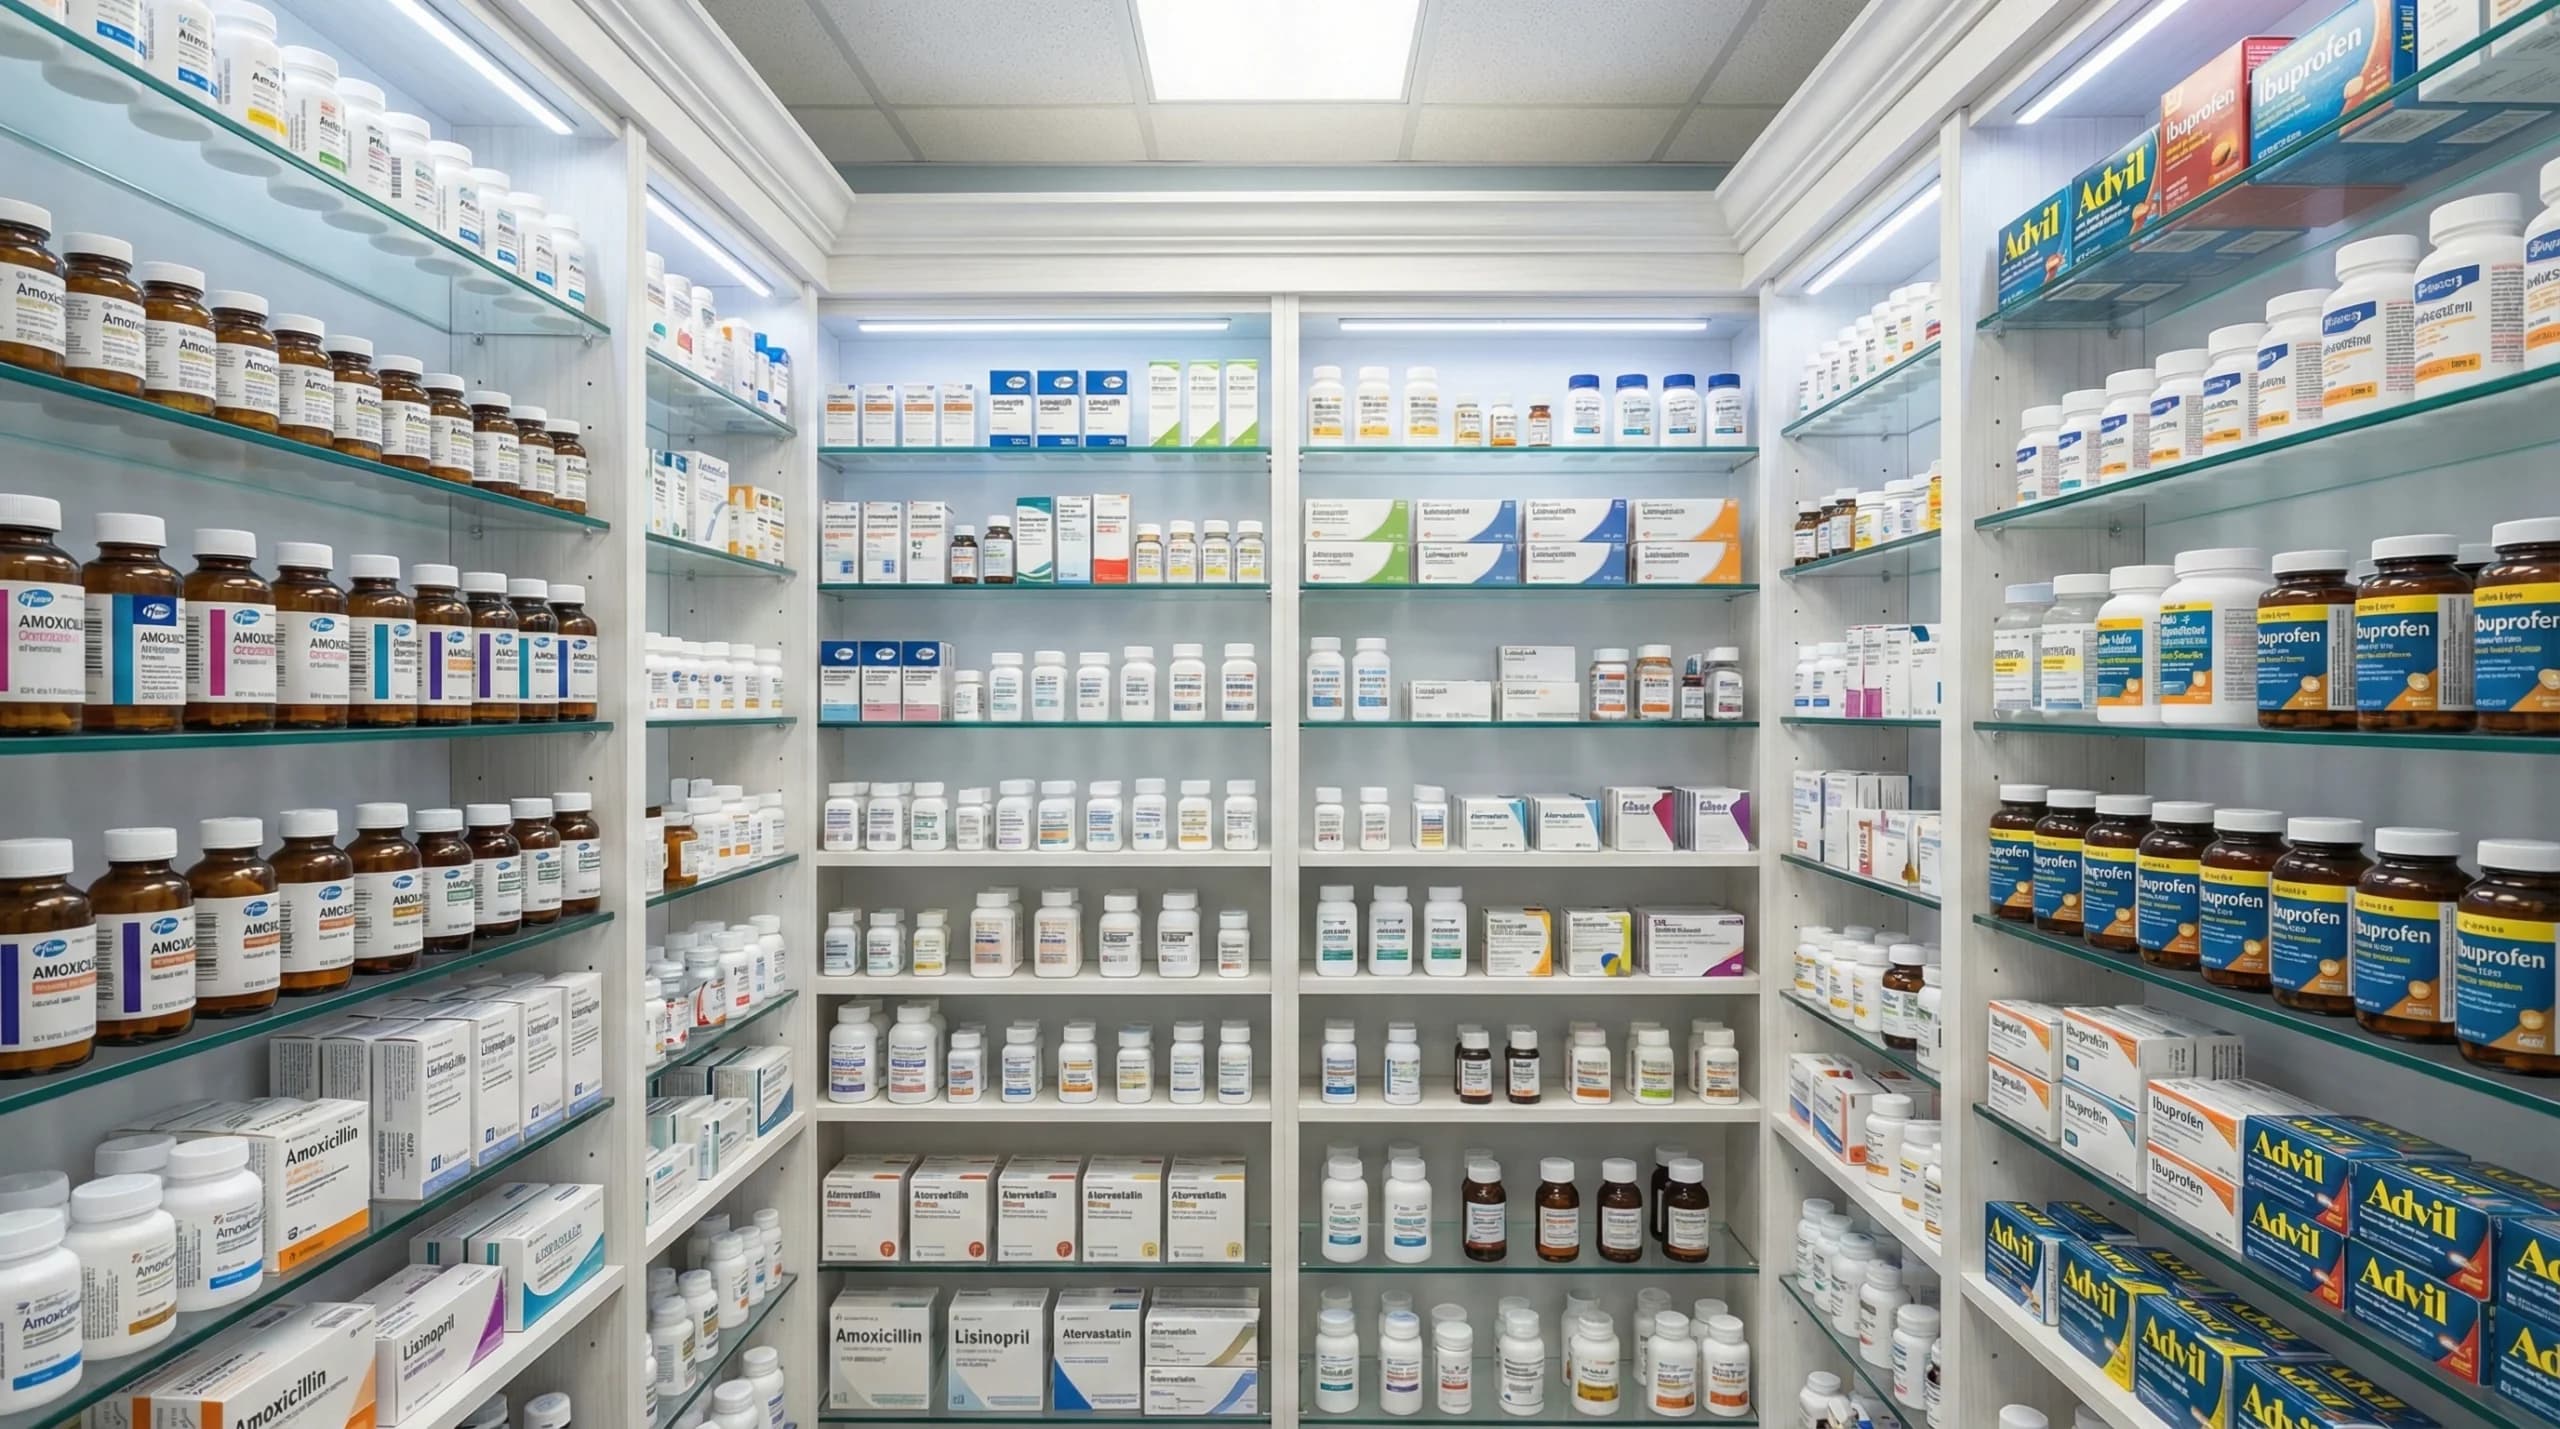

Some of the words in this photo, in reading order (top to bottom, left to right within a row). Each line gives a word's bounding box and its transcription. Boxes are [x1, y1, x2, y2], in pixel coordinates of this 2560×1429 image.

[2257, 26, 2363, 108] Ibuprofen
[2165, 87, 2235, 144] Ibuprofen
[2075, 146, 2147, 220] Advil
[2001, 202, 2060, 266] Advil
[2258, 627, 2321, 648] buprofen
[2357, 620, 2431, 643] buprofen
[2152, 1095, 2204, 1132] Ibuprofen
[285, 1125, 358, 1167] Amoxicillin
[2253, 1130, 2324, 1184] Advil
[2251, 1201, 2320, 1260] Advil
[2366, 1178, 2458, 1241] Advil
[1989, 1216, 2035, 1269] Advil
[2063, 1259, 2117, 1320] Advil
[2359, 1256, 2447, 1326] Advil
[836, 1327, 922, 1344] Amoxicillin
[955, 1328, 1030, 1348] Lisinopril
[2141, 1315, 2207, 1387] Advil
